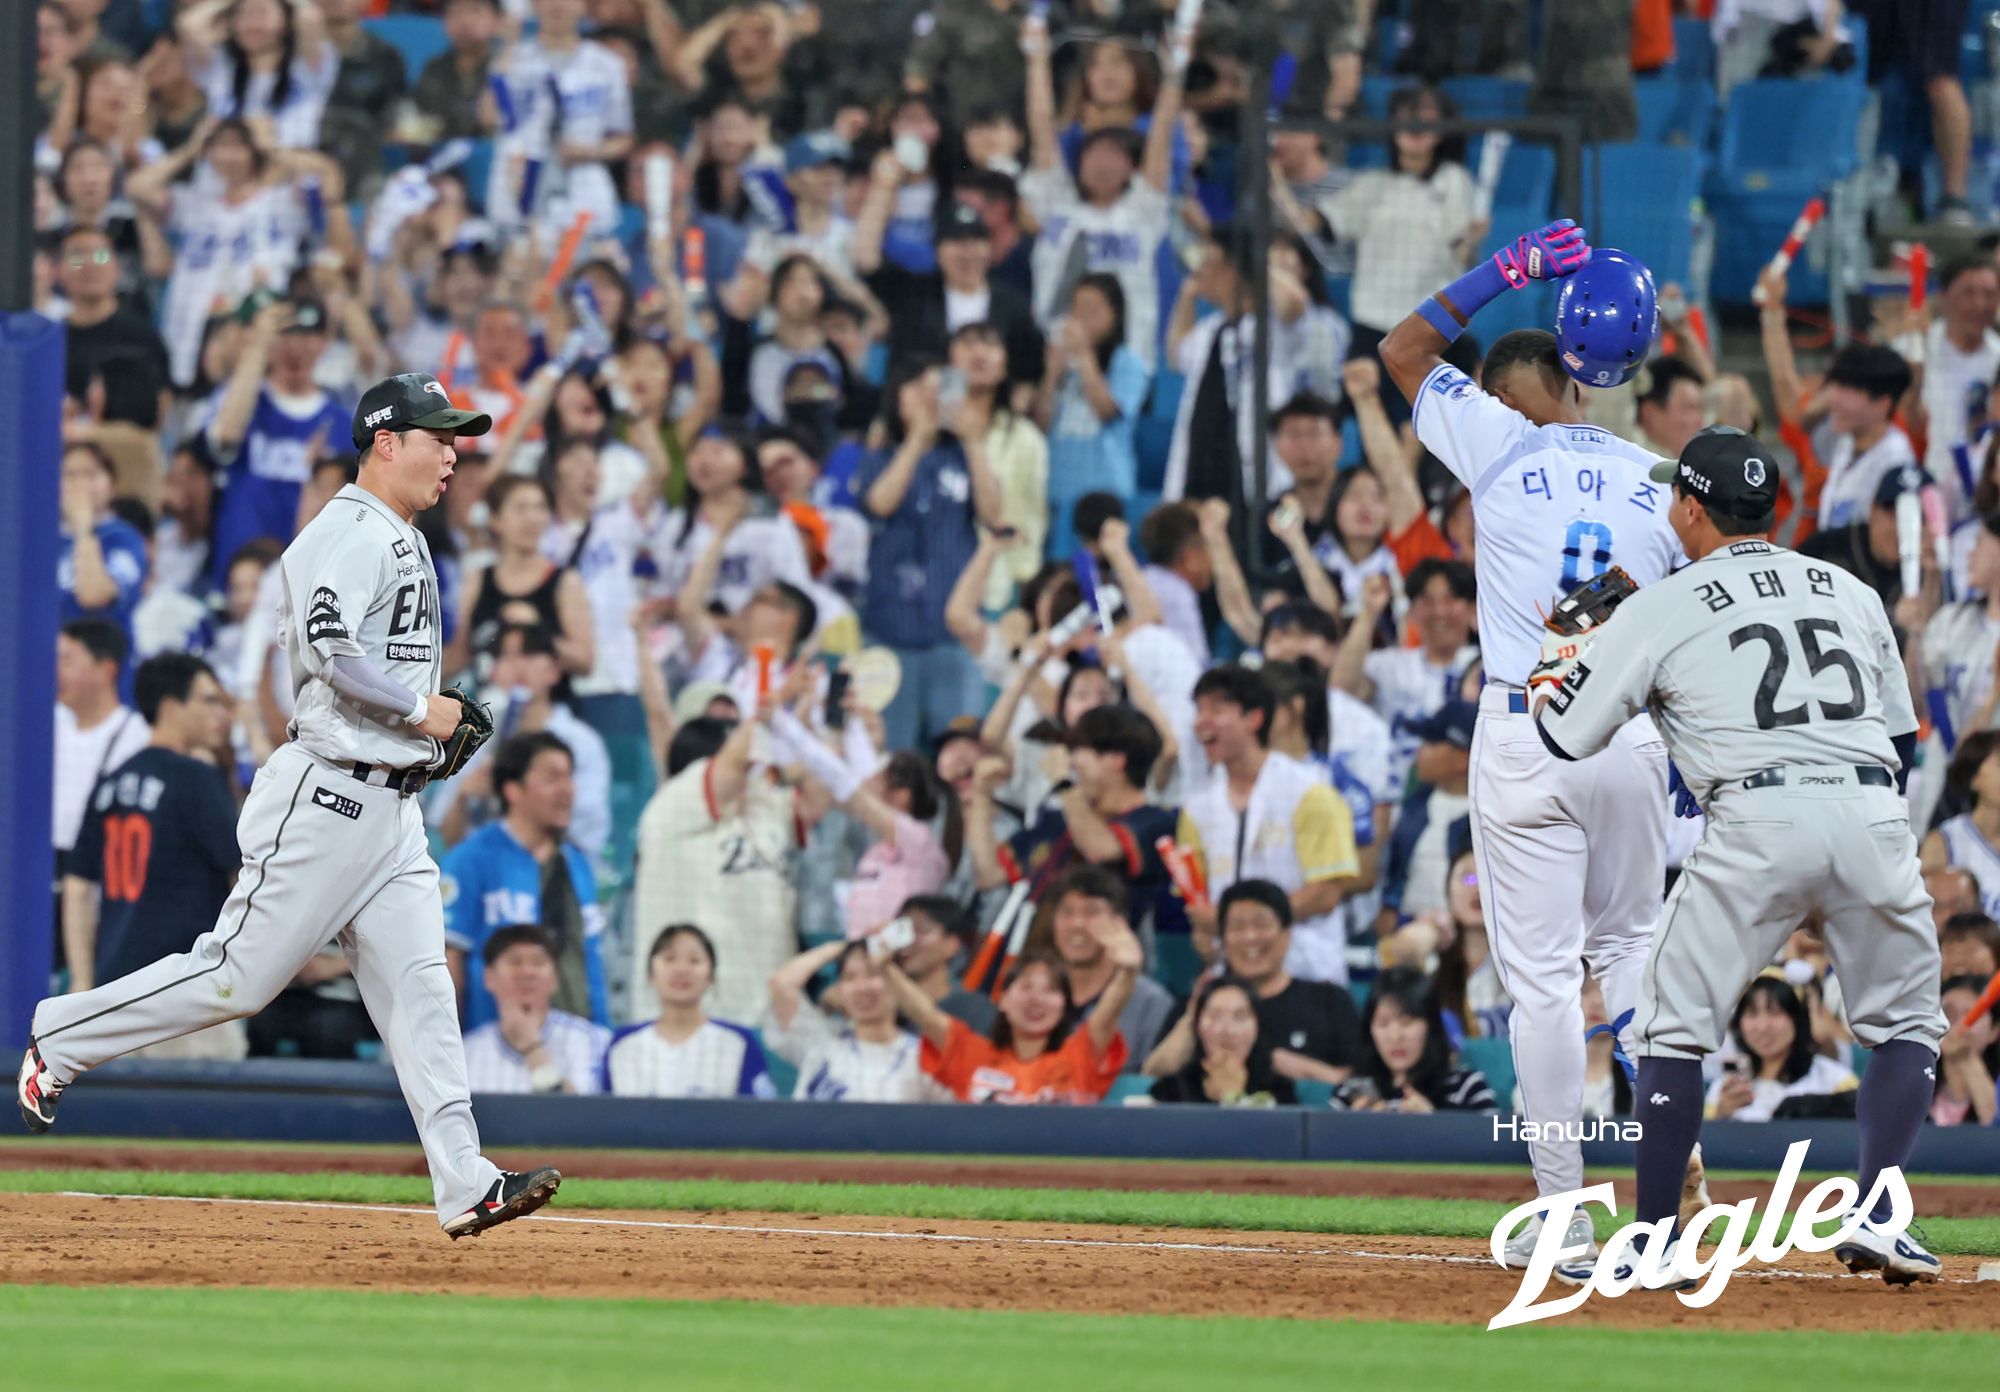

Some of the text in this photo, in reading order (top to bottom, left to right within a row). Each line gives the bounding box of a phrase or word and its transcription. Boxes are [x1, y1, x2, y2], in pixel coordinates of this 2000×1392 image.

[364, 405, 393, 428] 부루펜
[1521, 467, 1659, 514] 디아즈
[1558, 519, 1612, 594] 0
[311, 591, 341, 614] 화오션
[1692, 567, 1836, 613] 김태연
[387, 578, 430, 637] EA
[388, 644, 431, 661] 한화손해보험
[1728, 617, 1866, 730] 25
[1799, 776, 1845, 785] SPYDER
[335, 803, 358, 817] PLUS
[337, 797, 360, 811] LIFE
[103, 813, 153, 902] 10
